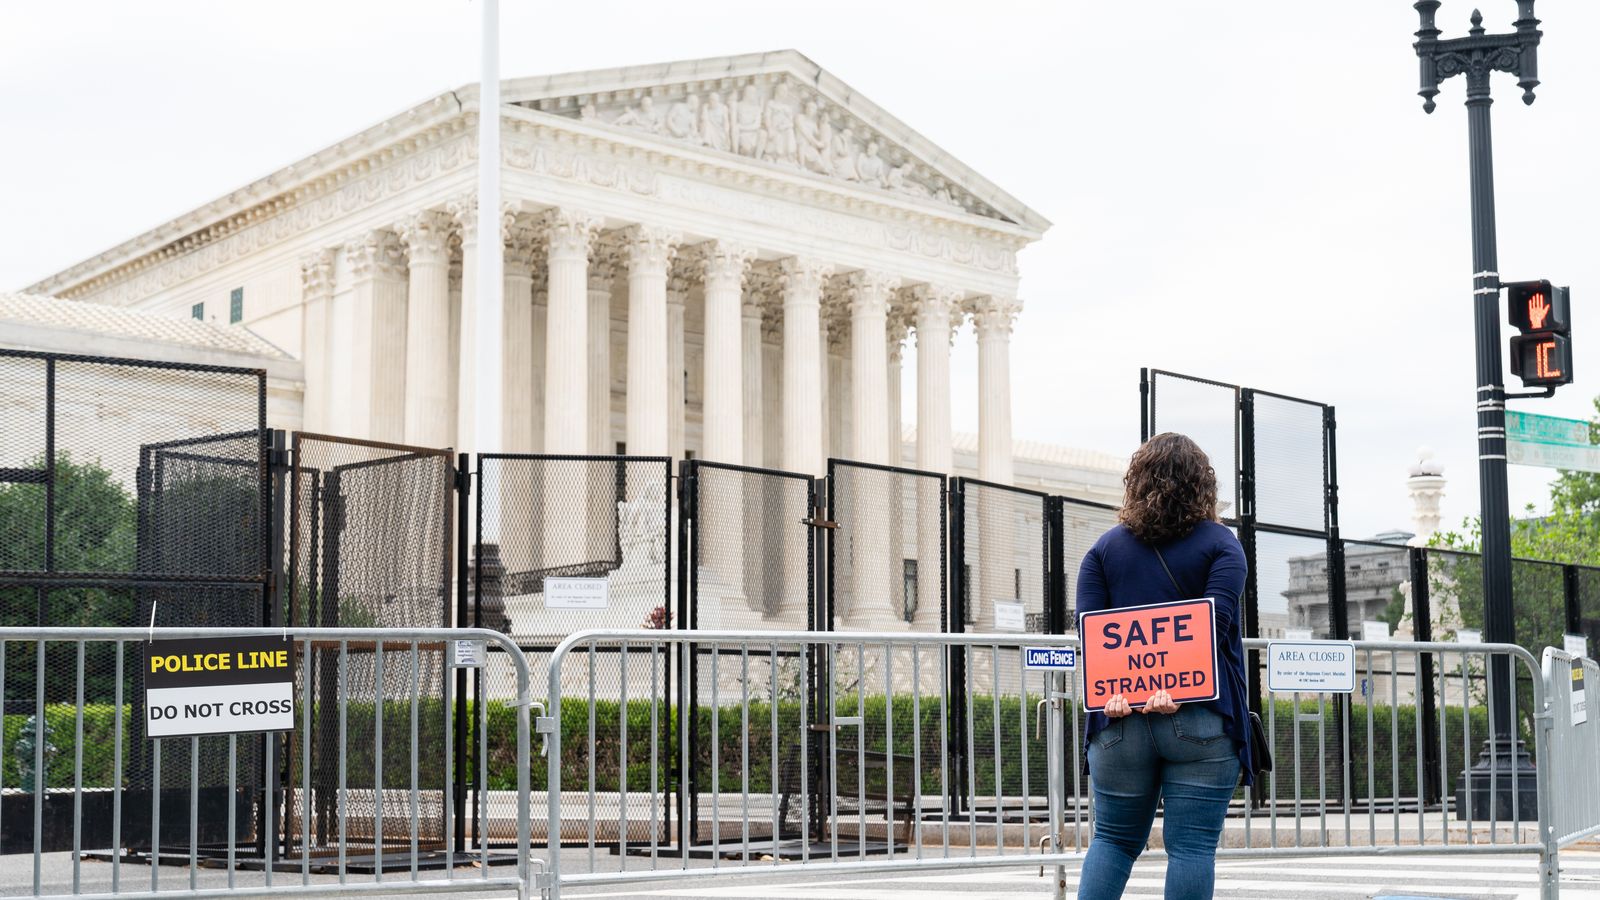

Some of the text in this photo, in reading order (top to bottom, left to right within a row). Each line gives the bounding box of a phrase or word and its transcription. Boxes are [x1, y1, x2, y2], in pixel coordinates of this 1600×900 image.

[1102, 614, 1193, 650] SAFE
[151, 650, 288, 673] POLICE LINE
[1050, 650, 1073, 665] FENCE
[1128, 651, 1168, 670] NOT
[1278, 651, 1345, 662] AREA CLOSED
[1094, 670, 1206, 696] STRANDED
[150, 699, 291, 720] DO NOT CROSS
